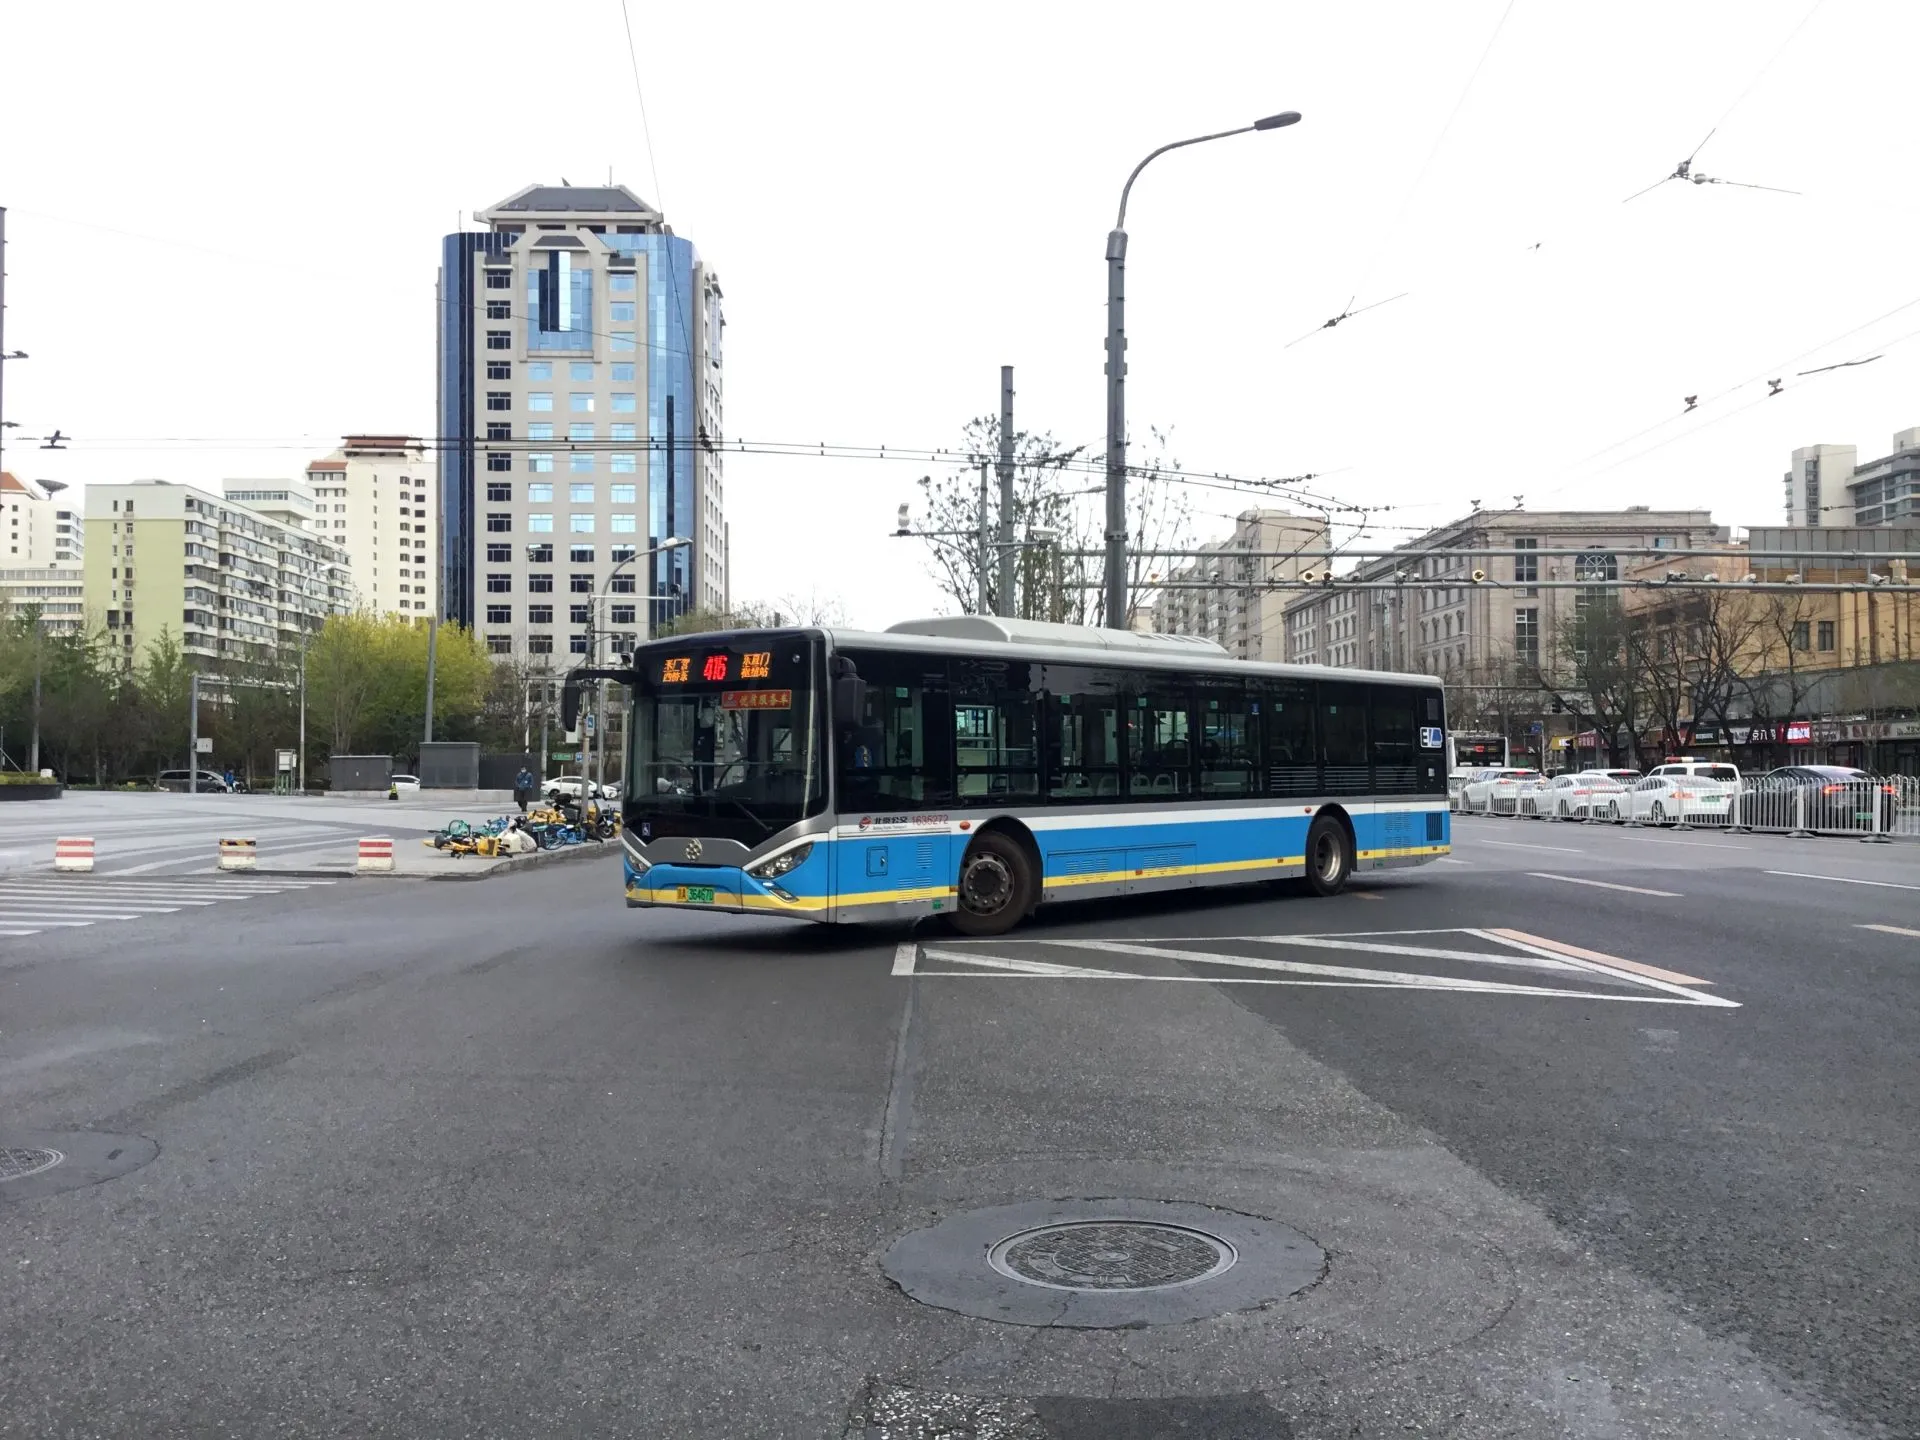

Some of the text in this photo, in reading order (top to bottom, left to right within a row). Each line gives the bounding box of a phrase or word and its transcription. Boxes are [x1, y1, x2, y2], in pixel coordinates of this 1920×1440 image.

[743, 652, 771, 667] 东直门
[703, 655, 728, 681] 416
[874, 815, 908, 825] 北京公交
